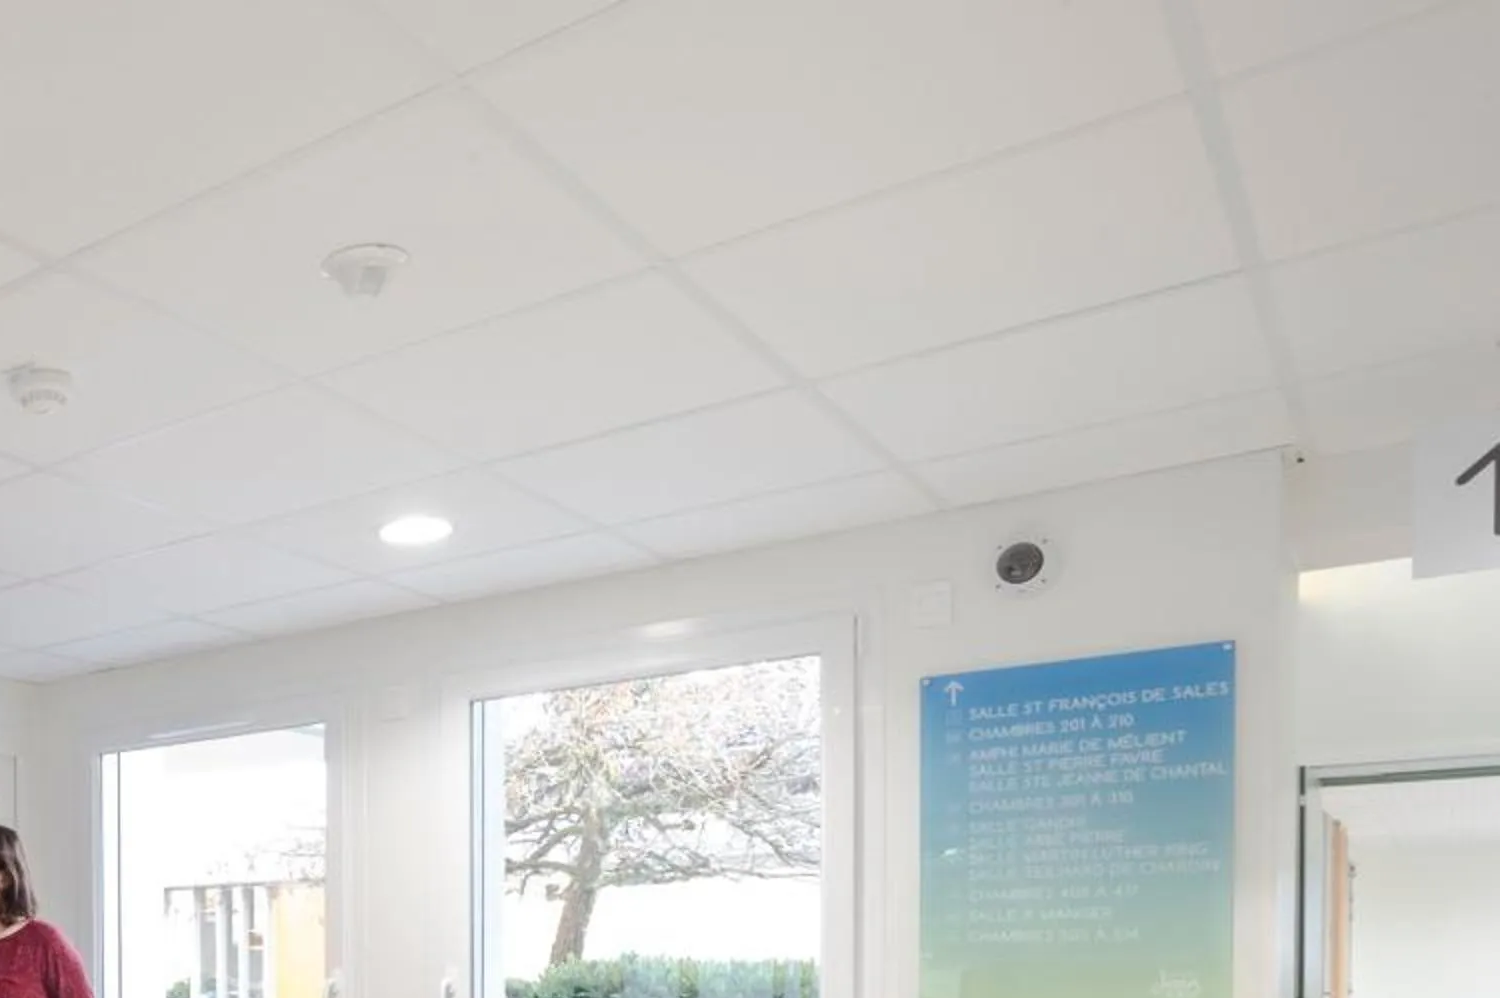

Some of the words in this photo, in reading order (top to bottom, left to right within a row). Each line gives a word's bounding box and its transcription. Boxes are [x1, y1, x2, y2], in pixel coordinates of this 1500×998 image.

[969, 702, 1020, 721] SALLE
[1023, 700, 1043, 716] ST
[1048, 689, 1138, 713] FRANÇOIS
[1141, 686, 1166, 703] DE
[1172, 680, 1229, 701] SALES
[968, 721, 1056, 741] CHAMBRES
[1059, 718, 1085, 734] 201
[1078, 737, 1103, 754] DE
[1023, 758, 1043, 775] ST
